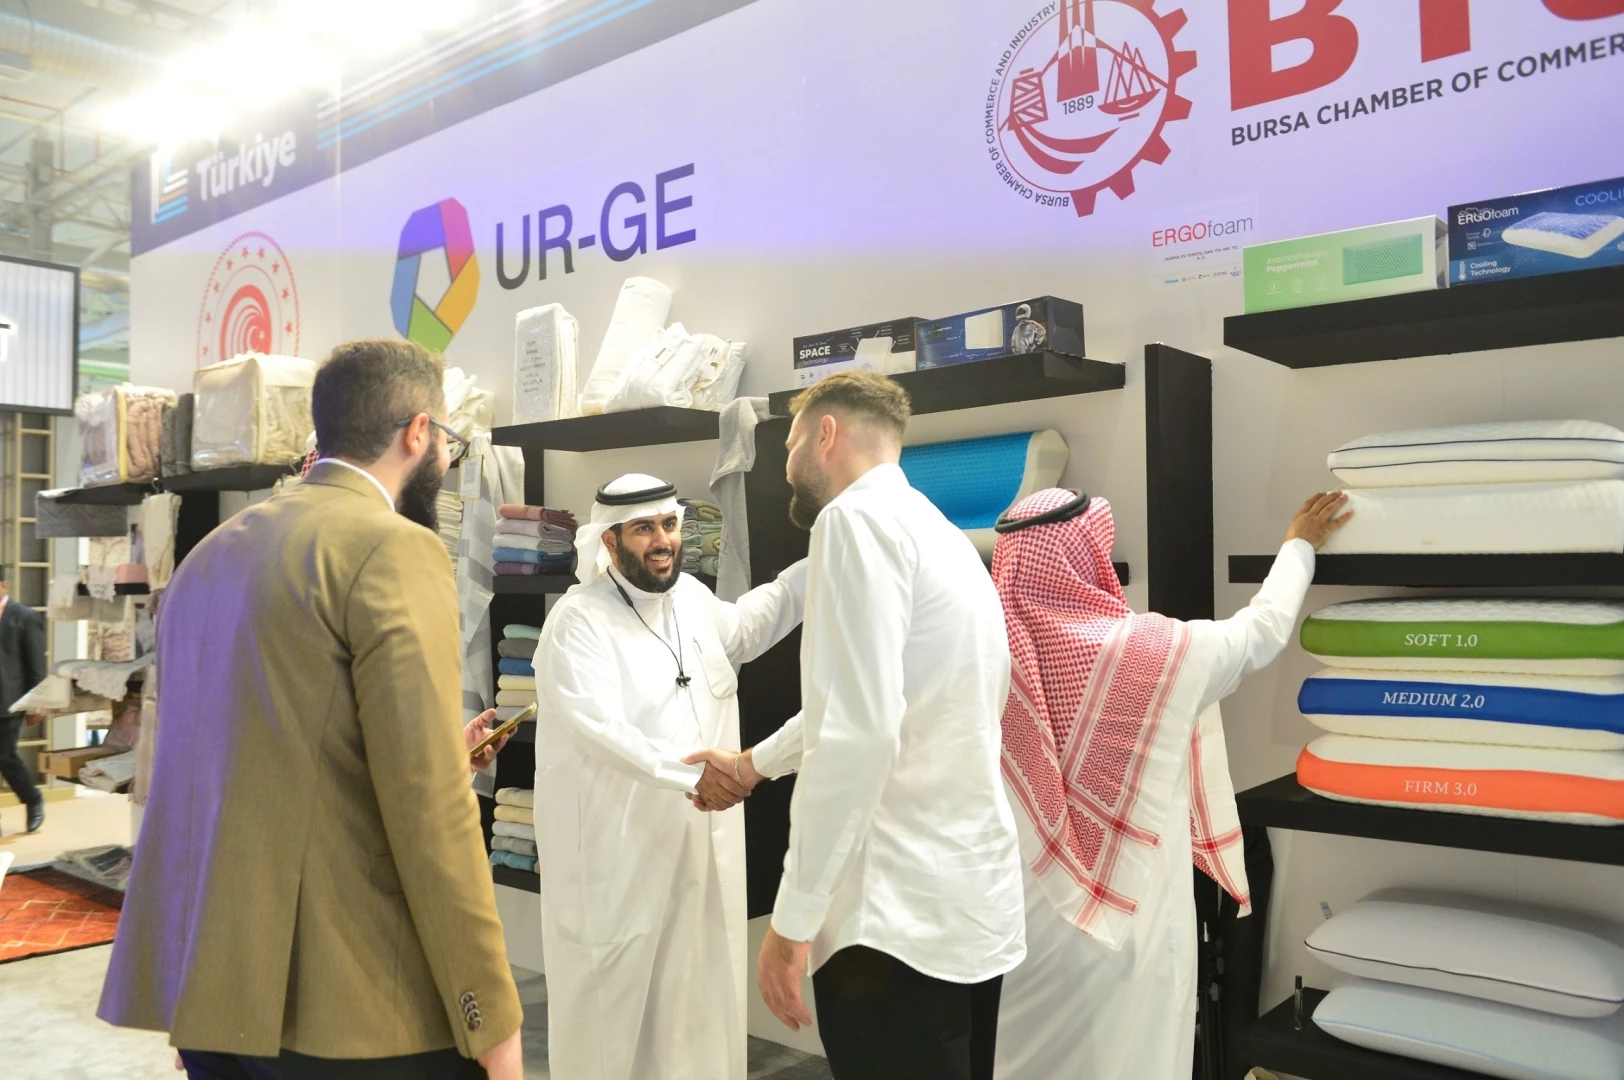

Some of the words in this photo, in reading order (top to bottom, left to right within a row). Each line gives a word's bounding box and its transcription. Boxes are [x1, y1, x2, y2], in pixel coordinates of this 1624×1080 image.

[1009, 2, 1057, 50] INDUSTRY
[995, 50, 1012, 76] AND
[985, 78, 1000, 144] COMMERCE
[1063, 95, 1094, 115] 1889
[1231, 111, 1310, 146] BURSA
[1317, 78, 1443, 126] CHAMBER
[1451, 66, 1488, 93] OF
[988, 147, 1000, 162] OF
[197, 130, 296, 201] Türkiye
[995, 161, 1033, 199] CHAMBER
[1035, 192, 1069, 207] BURSA
[496, 162, 696, 290] UR-GE
[1457, 206, 1519, 226] ERGOfoam
[1152, 217, 1253, 247] ERGOfoam
[1266, 258, 1318, 273] Peppermint
[1470, 260, 1497, 270] Cooling
[1471, 265, 1511, 277] Technology
[799, 345, 831, 359] SPACE
[1404, 633, 1451, 647] SOFT
[1456, 633, 1478, 648] 1.0
[1383, 691, 1456, 707] MEDIUM
[1461, 693, 1485, 709] 2.0
[1404, 779, 1450, 795] FIRM
[1453, 781, 1478, 797] 3.0
